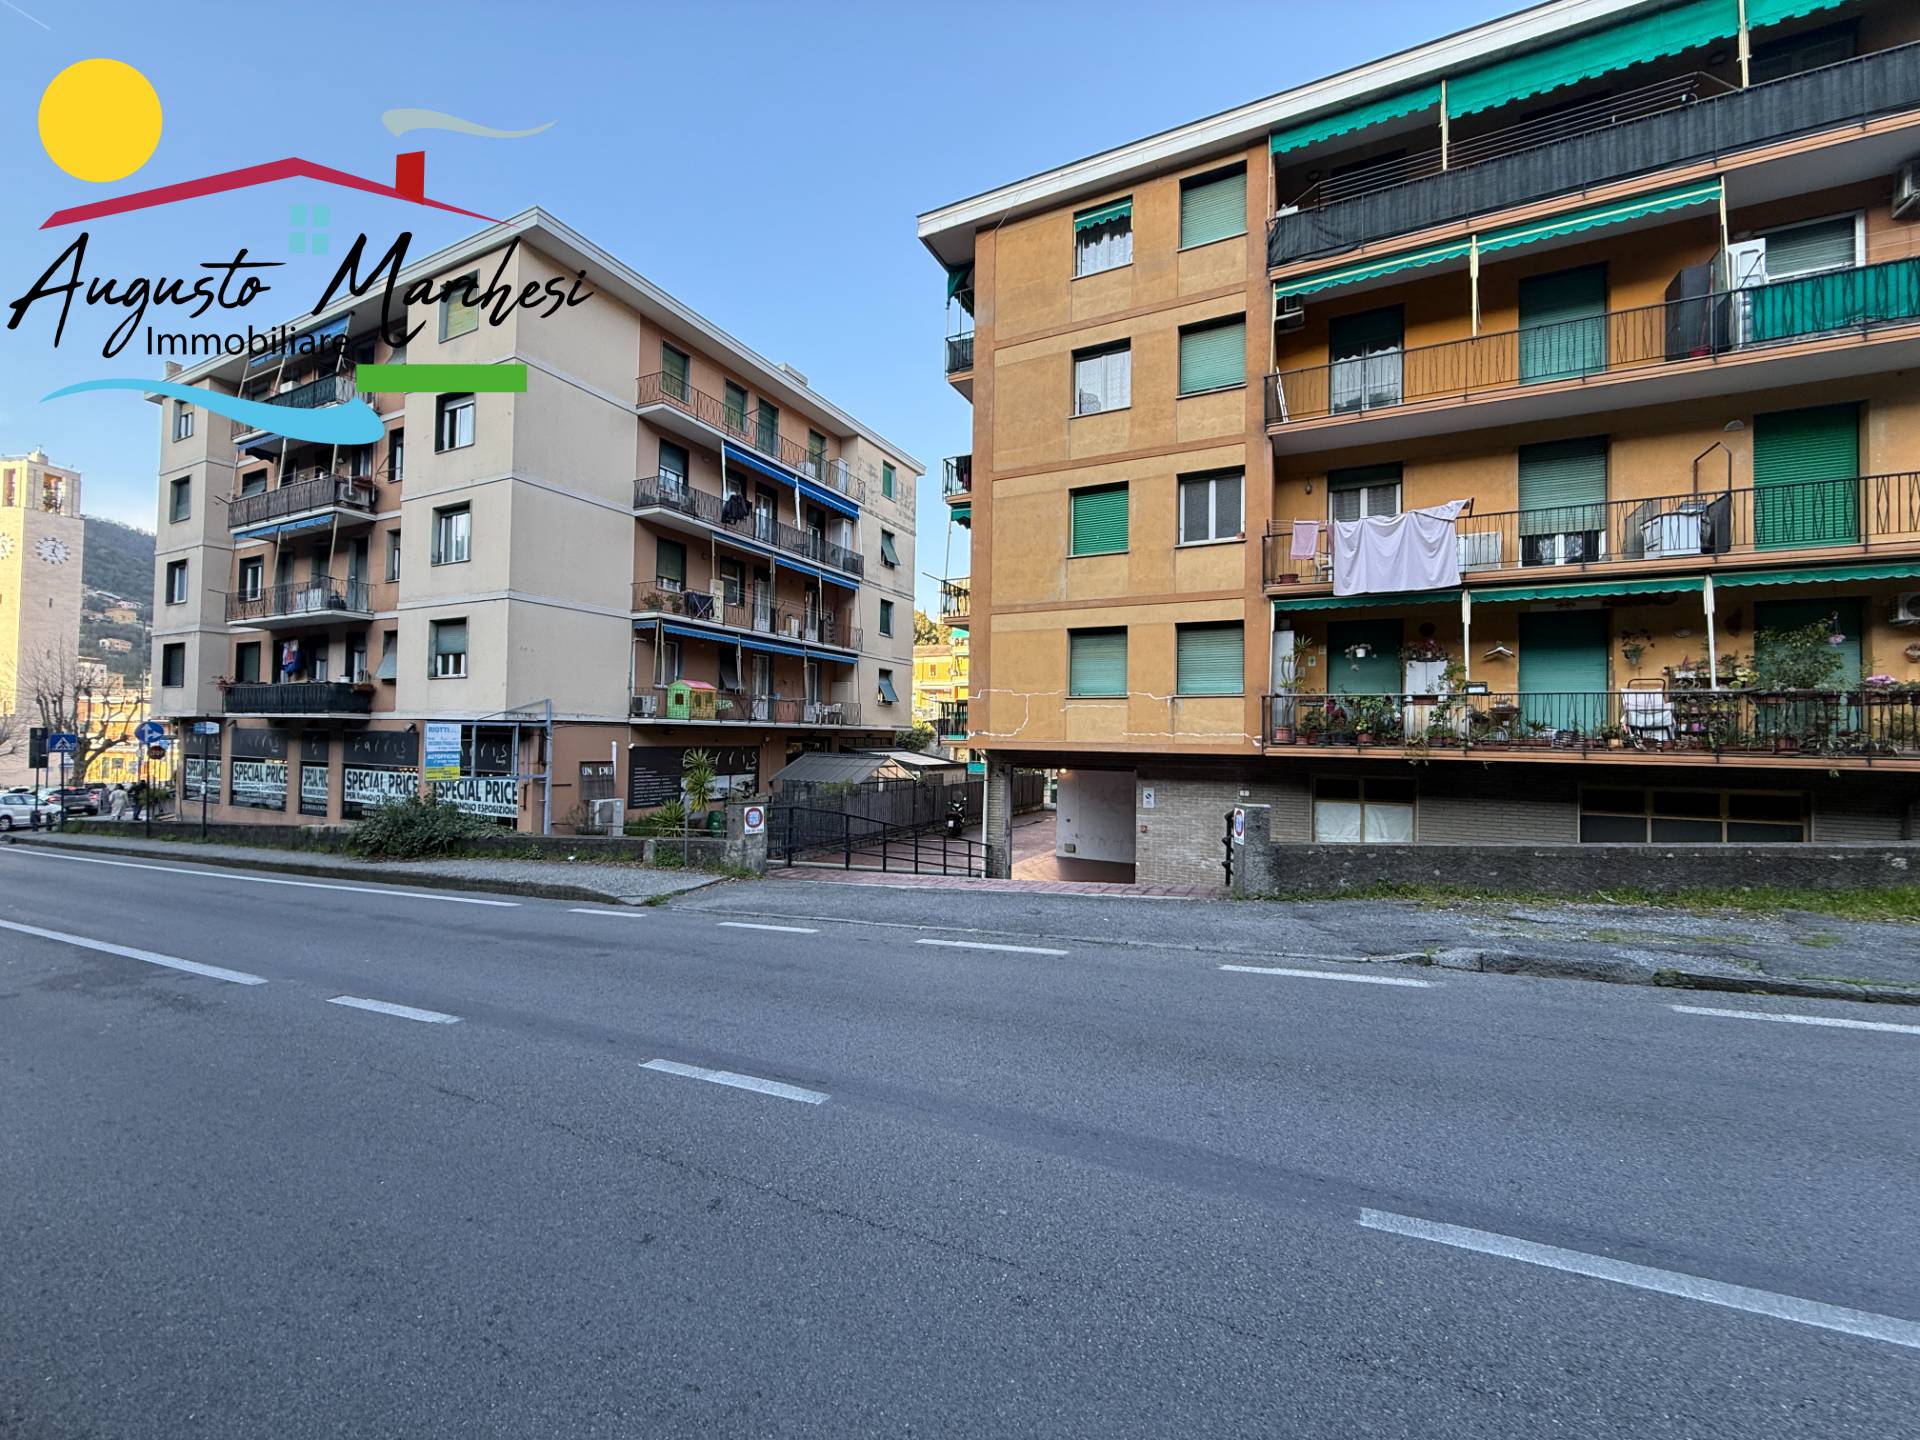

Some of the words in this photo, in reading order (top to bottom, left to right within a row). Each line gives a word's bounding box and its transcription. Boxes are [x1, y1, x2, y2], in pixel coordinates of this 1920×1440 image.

[234, 763, 263, 783] SPECIAL
[346, 770, 383, 791] SPECIAL
[388, 774, 418, 796] PRICE
[437, 780, 481, 801] SPECIAL
[485, 781, 517, 805] PRICE
